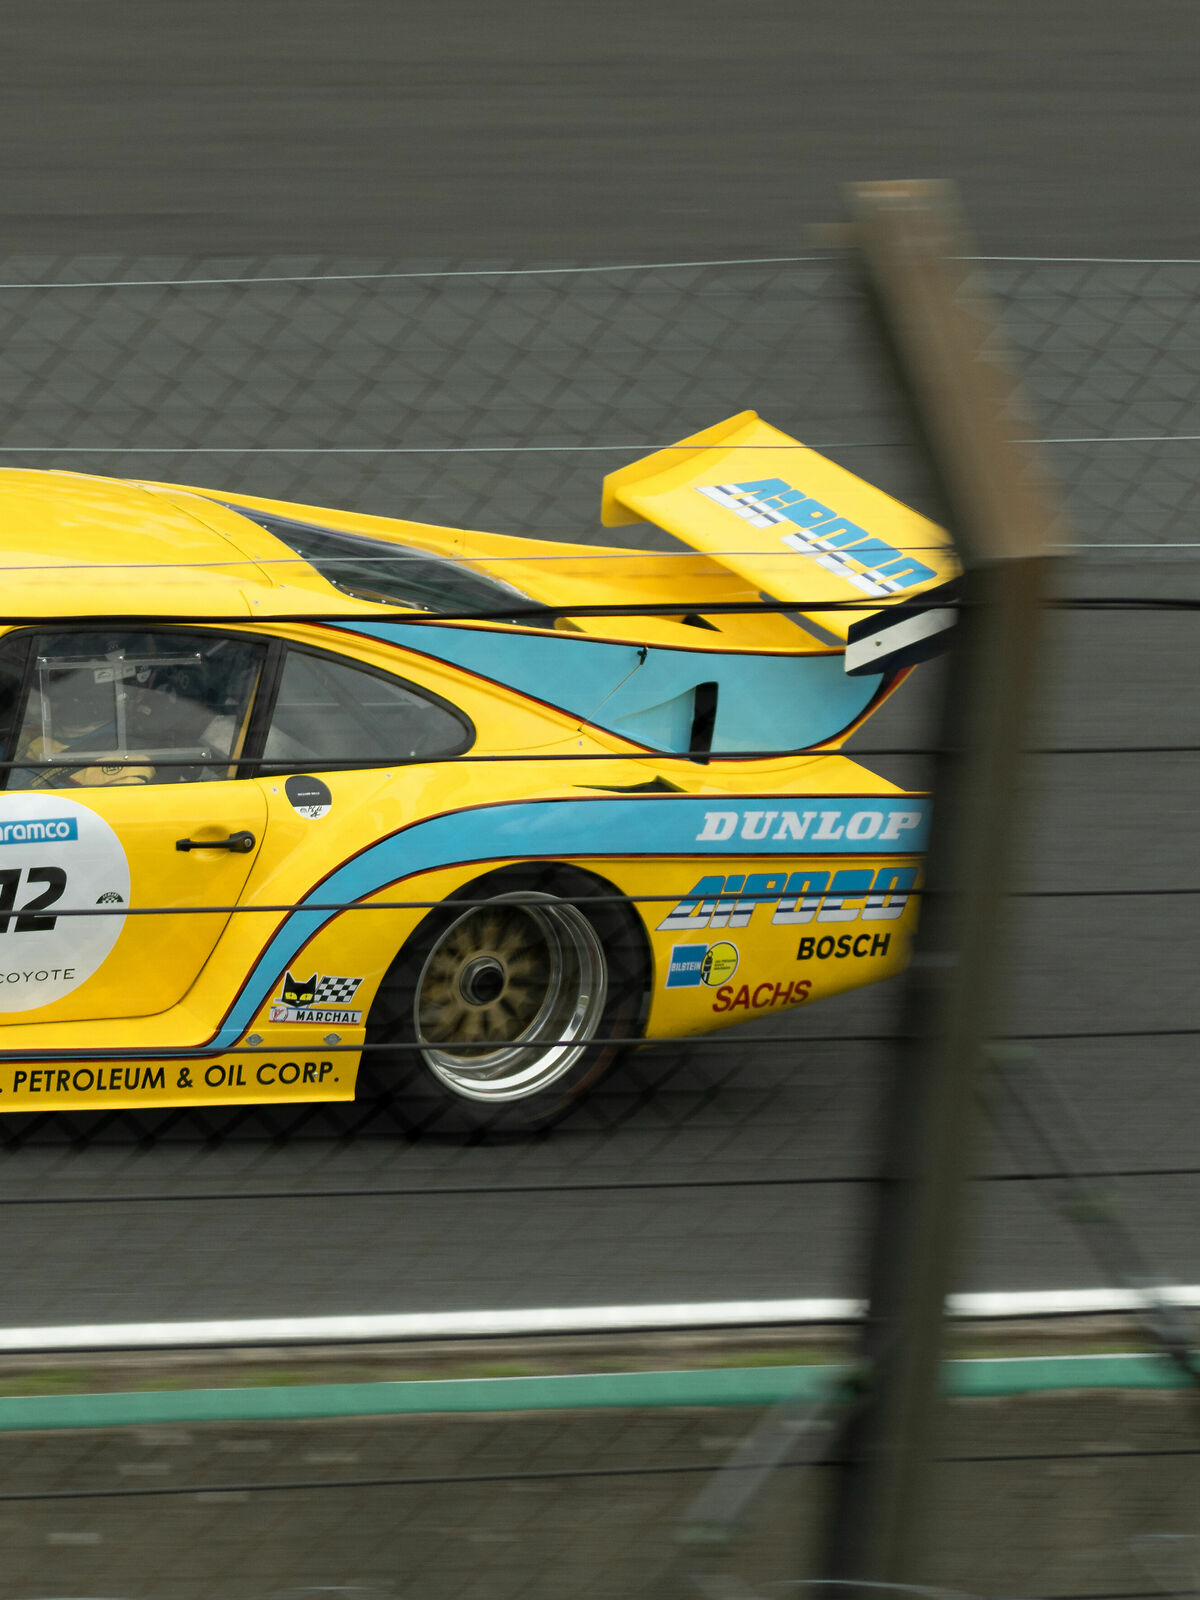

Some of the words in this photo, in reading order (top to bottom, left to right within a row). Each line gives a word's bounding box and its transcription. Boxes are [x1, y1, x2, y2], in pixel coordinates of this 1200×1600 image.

[695, 811, 922, 841] DUNLOP
[796, 933, 891, 960] BOSCH
[671, 961, 701, 972] BILSTEIN
[712, 980, 813, 1013] SACHS
[296, 1010, 357, 1023] MARCHAL
[13, 1067, 166, 1092] PETROLEUM
[176, 1067, 193, 1088] &
[204, 1064, 246, 1086] OIL
[256, 1061, 340, 1084] CORP.
